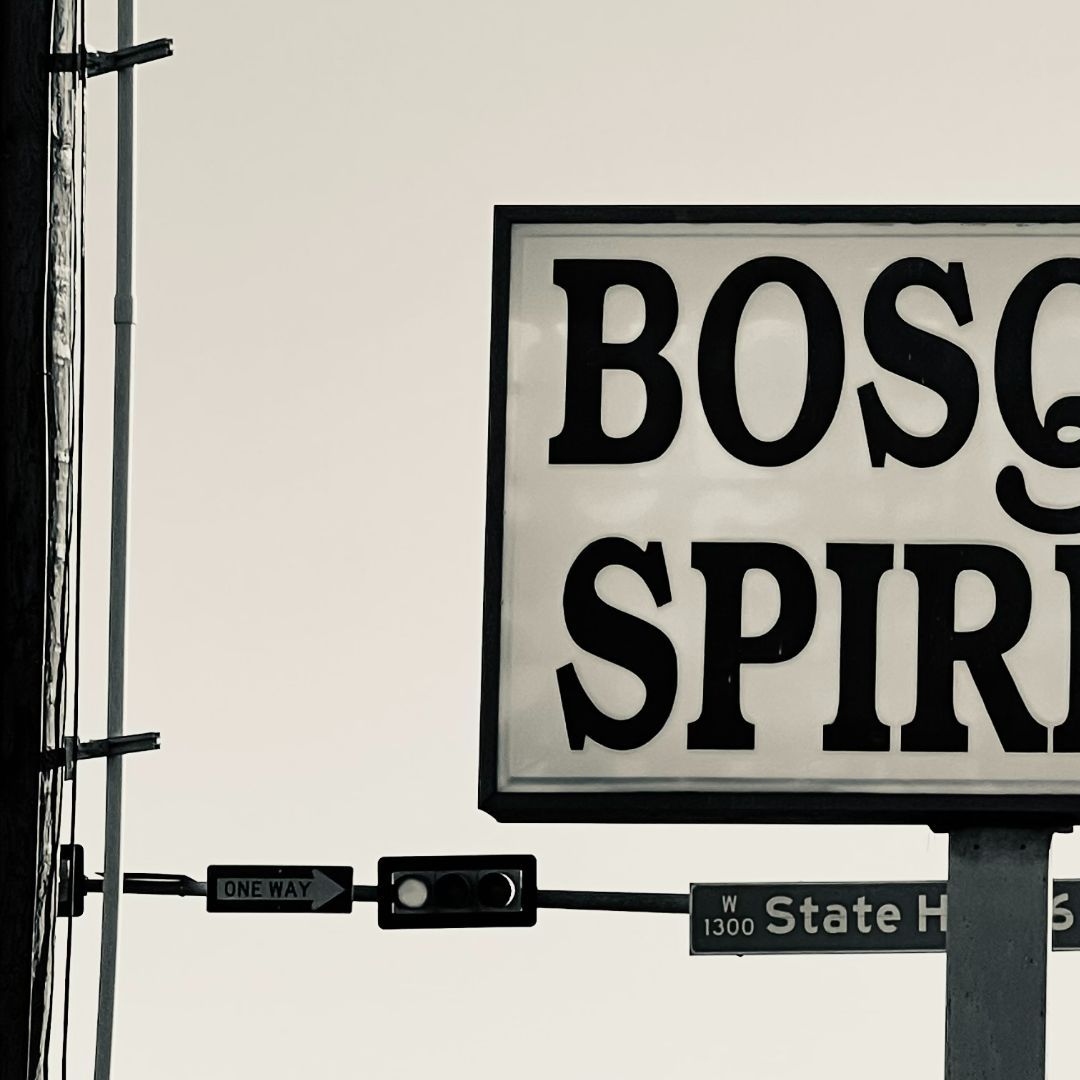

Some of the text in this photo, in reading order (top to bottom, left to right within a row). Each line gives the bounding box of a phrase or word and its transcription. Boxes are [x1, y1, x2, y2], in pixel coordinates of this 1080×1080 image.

[224, 881, 312, 898] ONE WAY
[721, 895, 738, 913] W
[765, 895, 902, 935] State
[1052, 892, 1074, 931] 6
[704, 917, 755, 937] 1300
